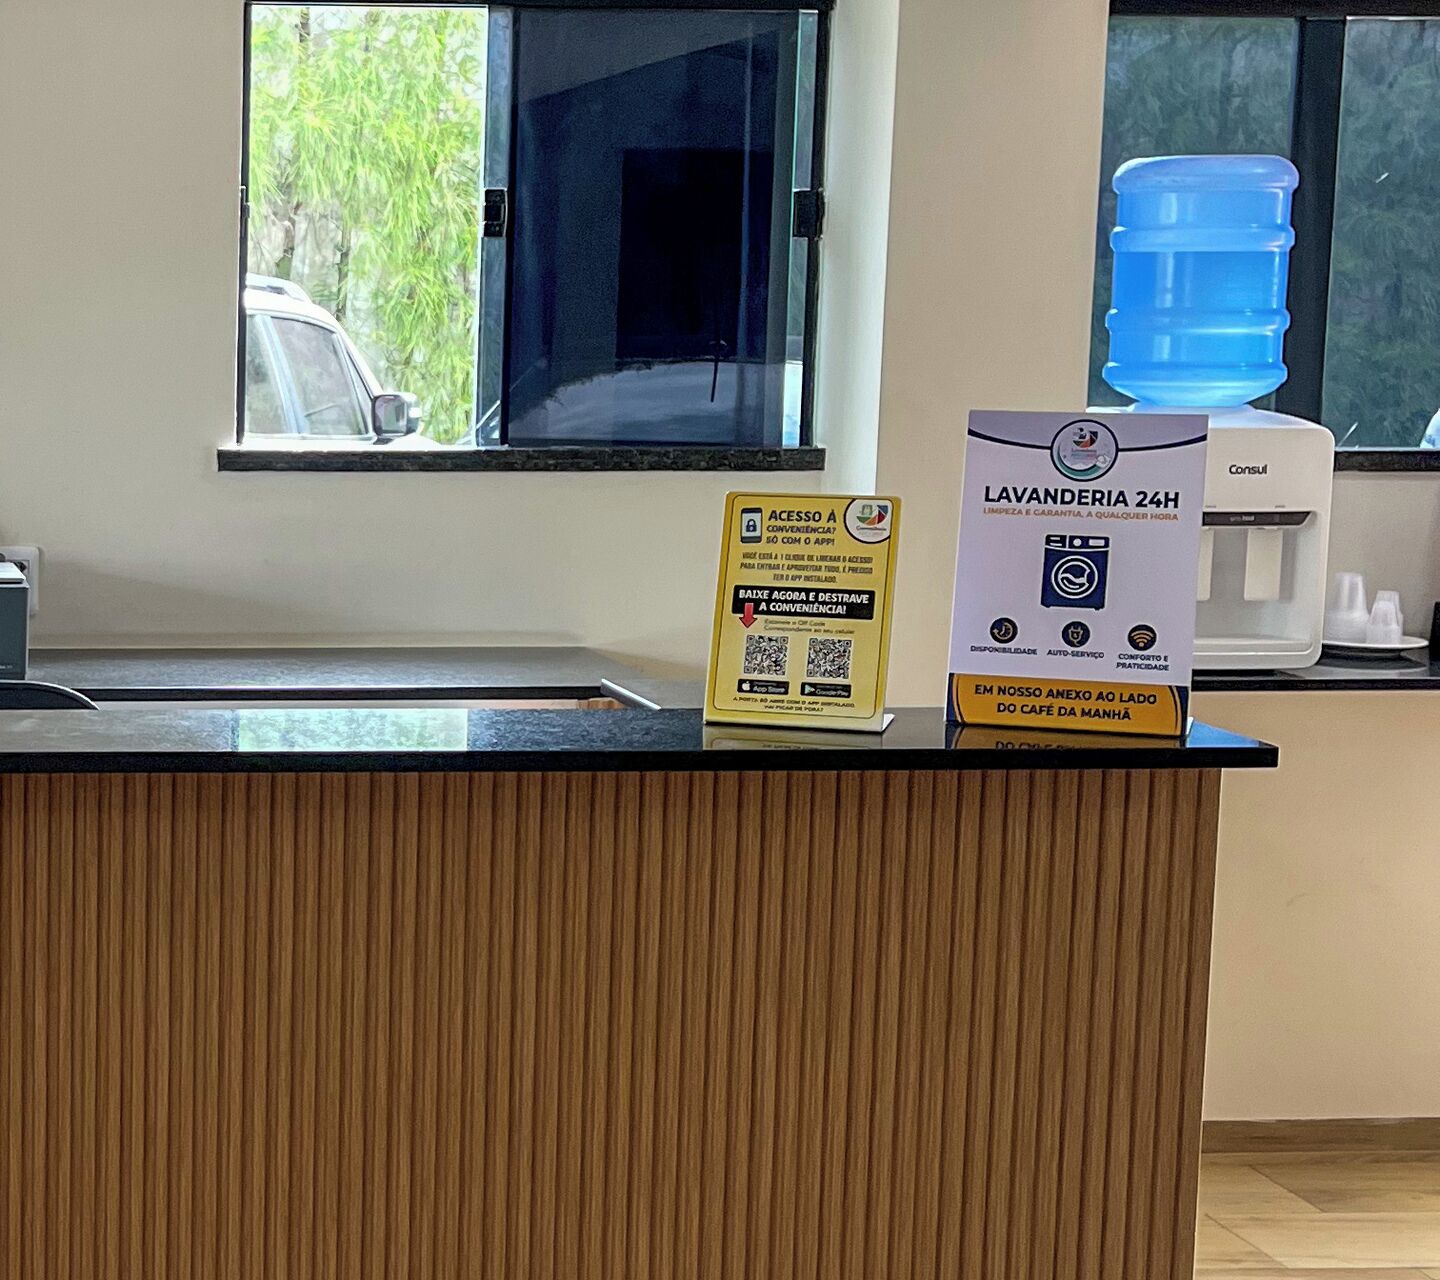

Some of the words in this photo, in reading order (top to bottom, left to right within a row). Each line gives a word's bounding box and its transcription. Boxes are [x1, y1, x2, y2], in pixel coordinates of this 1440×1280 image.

[1229, 464, 1267, 474] Consul
[984, 485, 1128, 507] LAVANDERIA
[1135, 491, 1179, 508] 24H
[768, 510, 822, 523] ACESSO
[827, 509, 836, 523] À
[983, 507, 1022, 516] LIMPEZA
[1026, 508, 1031, 516] E
[1033, 509, 1083, 518] GARANTIA,
[1095, 511, 1148, 520] QUALQUER
[1150, 512, 1179, 520] HORA
[766, 524, 836, 534] CONVENIÊNCIA?
[766, 535, 778, 544] SÓ
[814, 538, 834, 546] APP!
[786, 564, 822, 572] APROVEITAR
[739, 589, 769, 599] BAIXE
[772, 591, 806, 600] AGORA
[809, 592, 815, 600] E
[818, 592, 869, 604] DESTRAVE
[759, 602, 767, 611] A
[769, 602, 846, 614] CONVENIÊNCIA!
[970, 645, 1037, 655] DISPONIBILIDADE
[1047, 649, 1104, 659] AUTO-SERVIÇO
[1118, 653, 1161, 661] CONFORTO
[1116, 662, 1169, 671] PRATICIDADE
[752, 686, 767, 694] App
[768, 686, 786, 694] Store
[816, 688, 837, 696] Google
[974, 684, 993, 695] EM
[997, 685, 1042, 697] NOSSO
[1046, 688, 1092, 701] ANEXO
[1096, 691, 1115, 702] AO
[1120, 693, 1157, 704] LADO
[997, 703, 1016, 713] DO
[1020, 703, 1053, 716] CAFÉ
[1058, 706, 1076, 716] DA
[1081, 707, 1131, 720] MANHÃ
